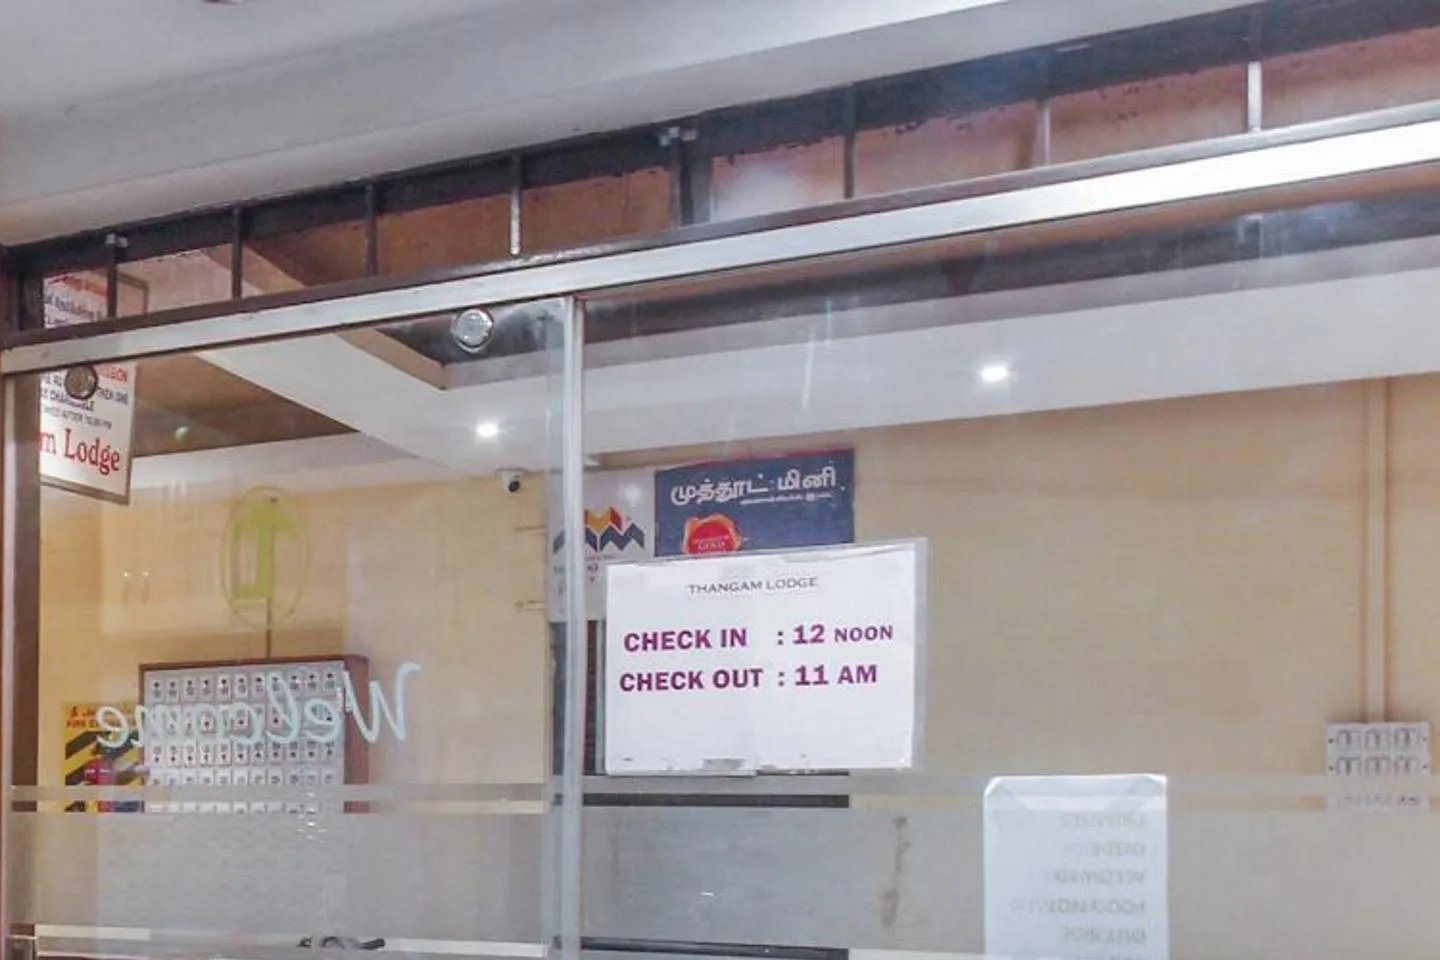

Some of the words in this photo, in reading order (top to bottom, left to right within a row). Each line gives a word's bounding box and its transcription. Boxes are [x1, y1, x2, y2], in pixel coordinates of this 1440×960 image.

[64, 427, 120, 475] Lodge
[689, 580, 761, 594] THANGAM
[766, 577, 819, 591] LODGE
[623, 628, 712, 652] CHECK
[720, 628, 748, 648] IN
[792, 624, 825, 645] 12
[834, 625, 894, 643] NOON
[619, 670, 705, 692] CHECK
[713, 668, 765, 689] OUT
[795, 665, 828, 686] 11
[837, 664, 877, 684] AM
